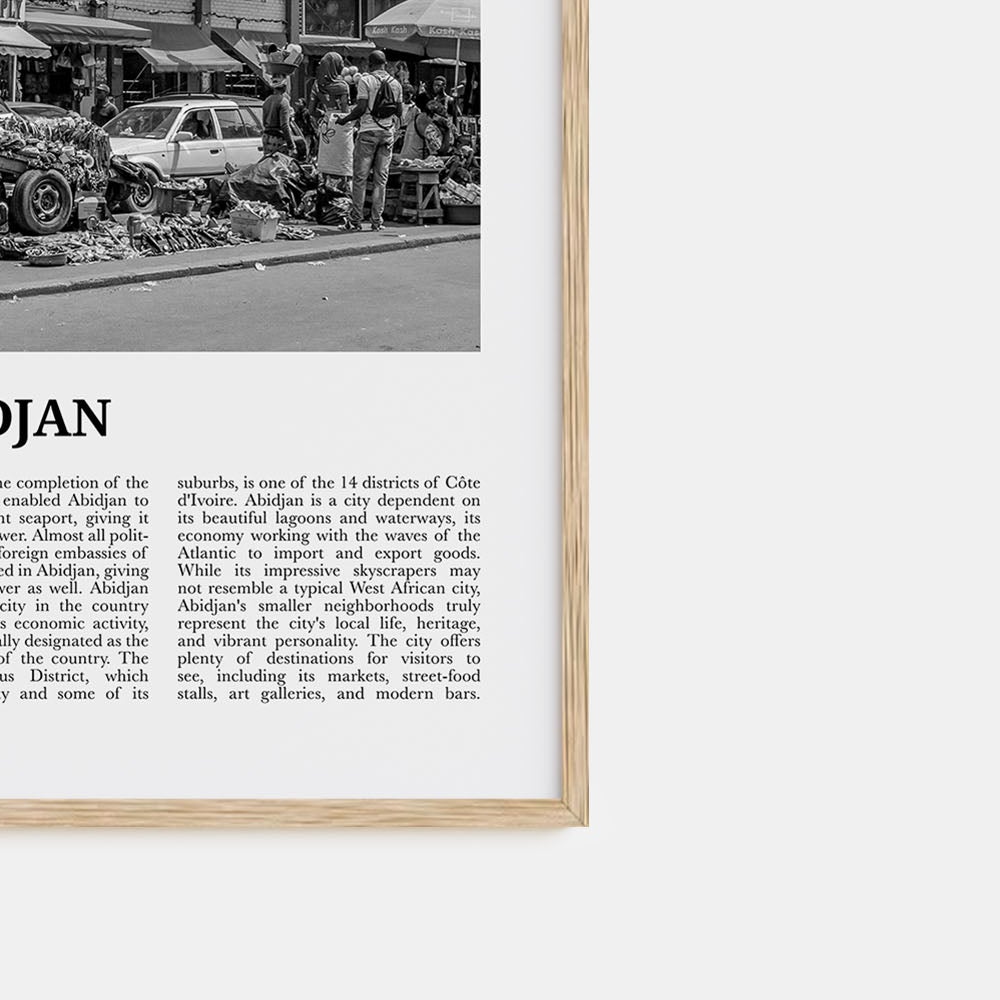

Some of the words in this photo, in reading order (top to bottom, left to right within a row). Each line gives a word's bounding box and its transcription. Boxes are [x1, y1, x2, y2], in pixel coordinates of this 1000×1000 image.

[16, 475, 99, 492] completion
[103, 475, 121, 488] of
[125, 475, 149, 488] the
[177, 475, 239, 491] suburbs,
[243, 475, 255, 488] is
[258, 479, 286, 488] one
[290, 475, 308, 488] of
[311, 475, 335, 488] the
[341, 475, 358, 488] 14
[361, 475, 420, 488] districts
[423, 475, 441, 488] of
[445, 474, 481, 488] Côte
[2, 493, 61, 506] enabled
[67, 493, 127, 510] Abidjan
[134, 495, 149, 506] to
[177, 510, 195, 523] its
[202, 510, 267, 523] beautiful
[275, 510, 332, 527] lagoons
[339, 510, 368, 523] and
[375, 512, 456, 527] waterways,
[464, 510, 481, 523] its
[54, 545, 127, 558] embassies
[131, 545, 149, 558] of
[177, 545, 237, 558] Atlantic
[248, 547, 263, 558] to
[273, 545, 324, 562] import
[335, 545, 364, 558] and
[374, 547, 423, 562] export
[433, 545, 481, 562] goods.
[177, 563, 222, 576] While
[234, 563, 252, 576] its
[264, 563, 341, 580] impressive
[353, 563, 437, 580] skyscrapers
[449, 567, 481, 580] may
[258, 598, 313, 611] smaller
[324, 598, 435, 615] neighborhoods
[446, 598, 481, 615] truly
[13, 616, 85, 629] economic
[92, 616, 149, 633] activity,
[20, 651, 44, 664] the
[51, 653, 111, 668] country.
[117, 651, 149, 664] The
[30, 668, 90, 684] District,
[104, 668, 149, 681] which
[177, 672, 205, 684] see,
[216, 668, 287, 685] including
[298, 668, 316, 681] its
[327, 668, 390, 684] markets,
[402, 668, 481, 681] street-food
[19, 686, 48, 699] and
[57, 690, 96, 699] some
[105, 686, 123, 699] of
[132, 686, 149, 699] its
[177, 686, 218, 702] stalls,
[228, 688, 250, 699] art
[260, 686, 326, 703] galleries,
[336, 686, 365, 699] and
[375, 686, 434, 699] modern
[444, 686, 481, 699] bars.
